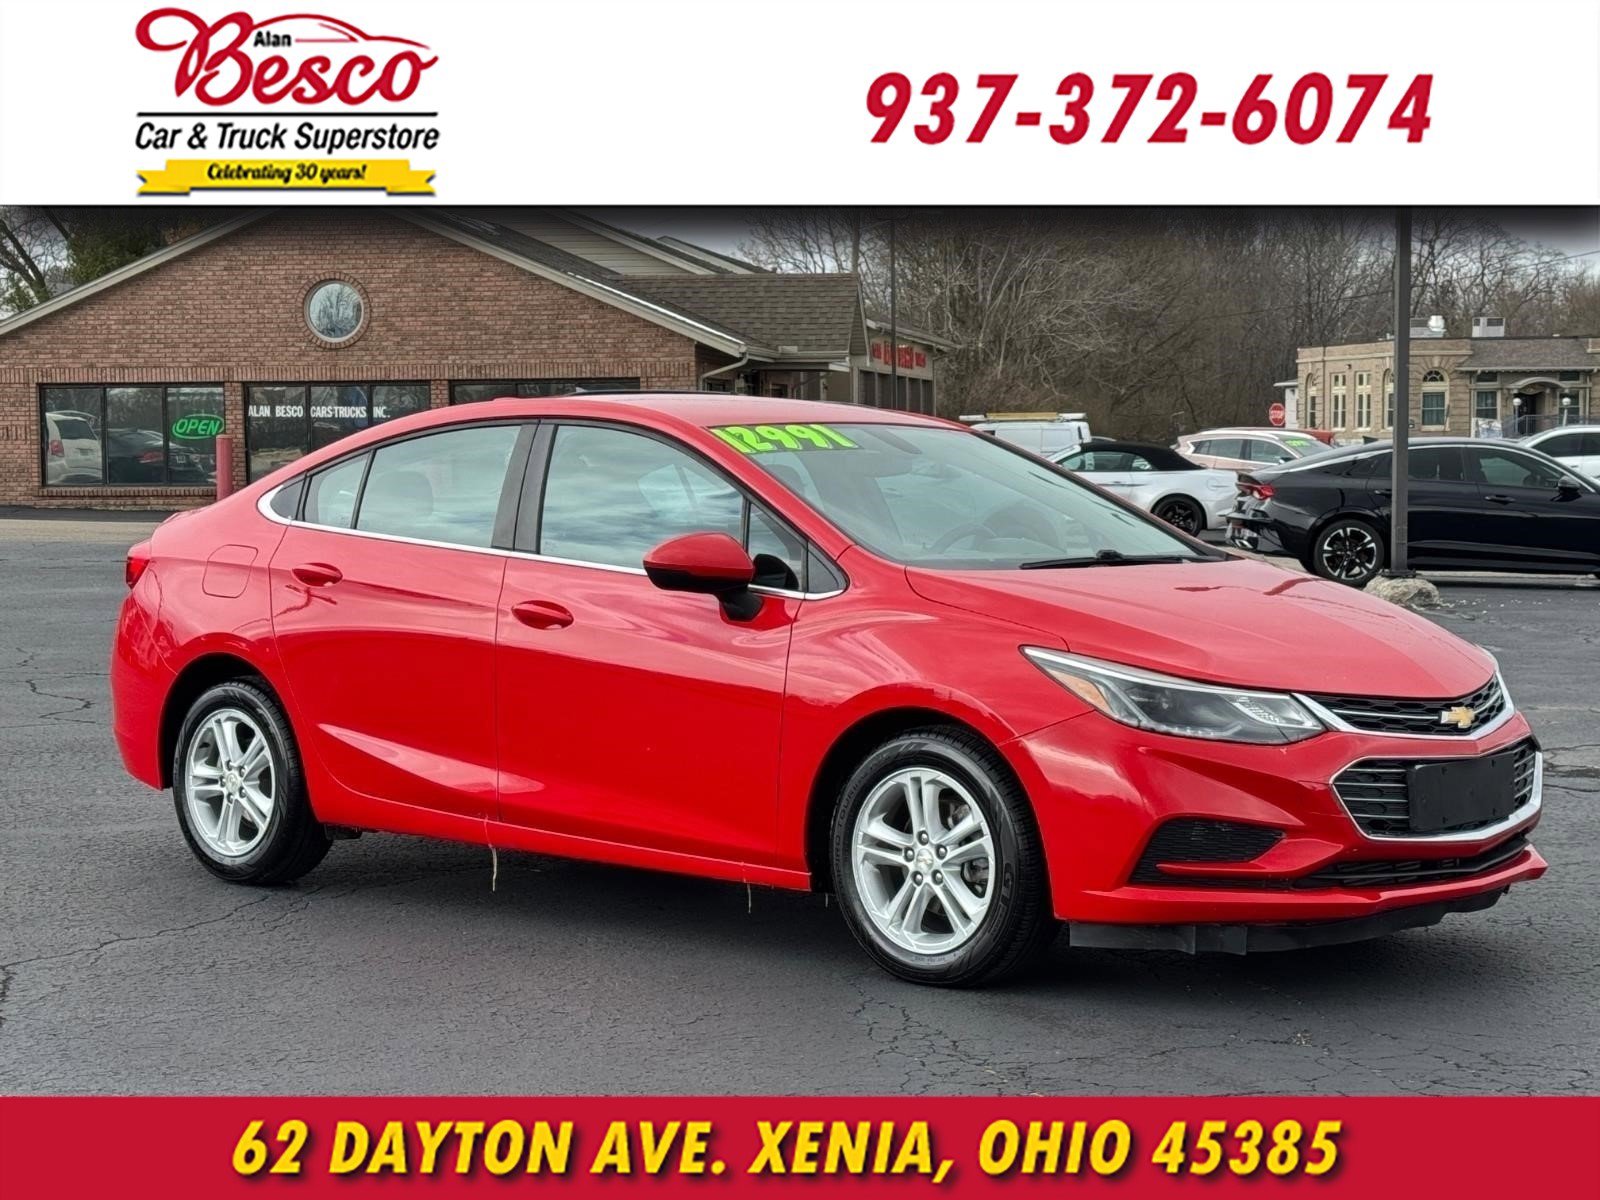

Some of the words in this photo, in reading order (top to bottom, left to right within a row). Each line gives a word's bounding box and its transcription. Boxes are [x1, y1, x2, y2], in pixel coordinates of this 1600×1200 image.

[248, 405, 271, 417] ALAN
[275, 405, 304, 418] BESCO
[373, 406, 391, 418] INC.
[175, 418, 220, 436] OPEN
[710, 424, 858, 453] 12991
